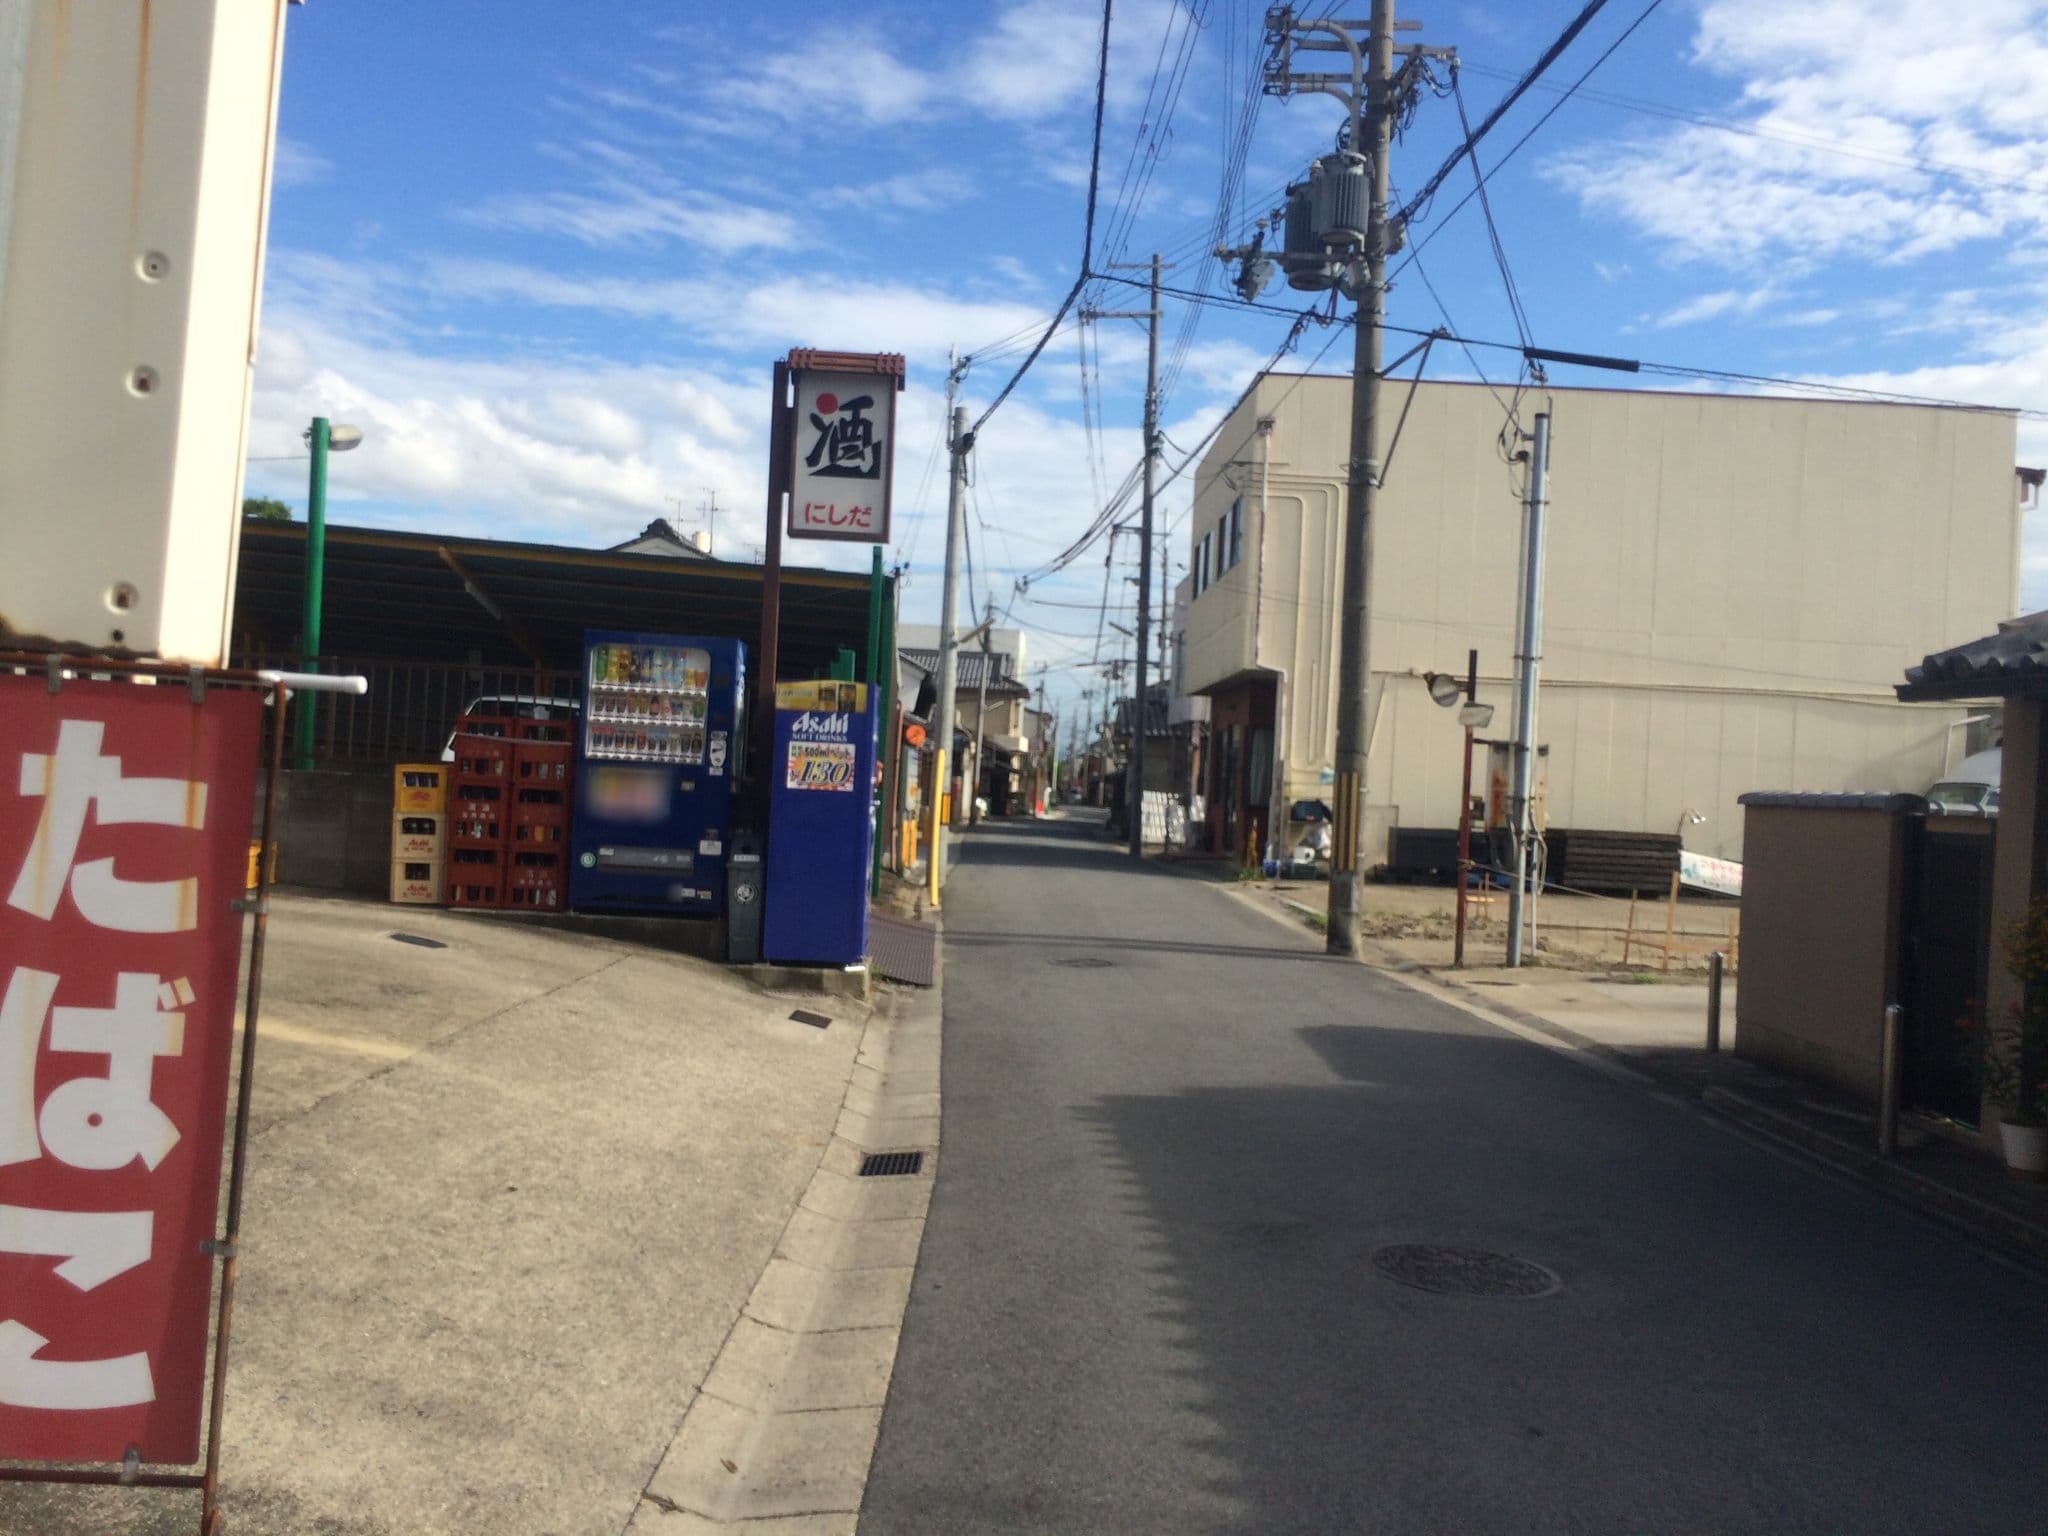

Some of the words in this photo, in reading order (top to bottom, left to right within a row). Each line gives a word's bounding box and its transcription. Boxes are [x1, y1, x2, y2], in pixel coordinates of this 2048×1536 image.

[805, 392, 883, 480] 酒
[804, 502, 873, 528] にしだ
[792, 711, 849, 734] Asahi
[0, 719, 208, 1410] たばこ
